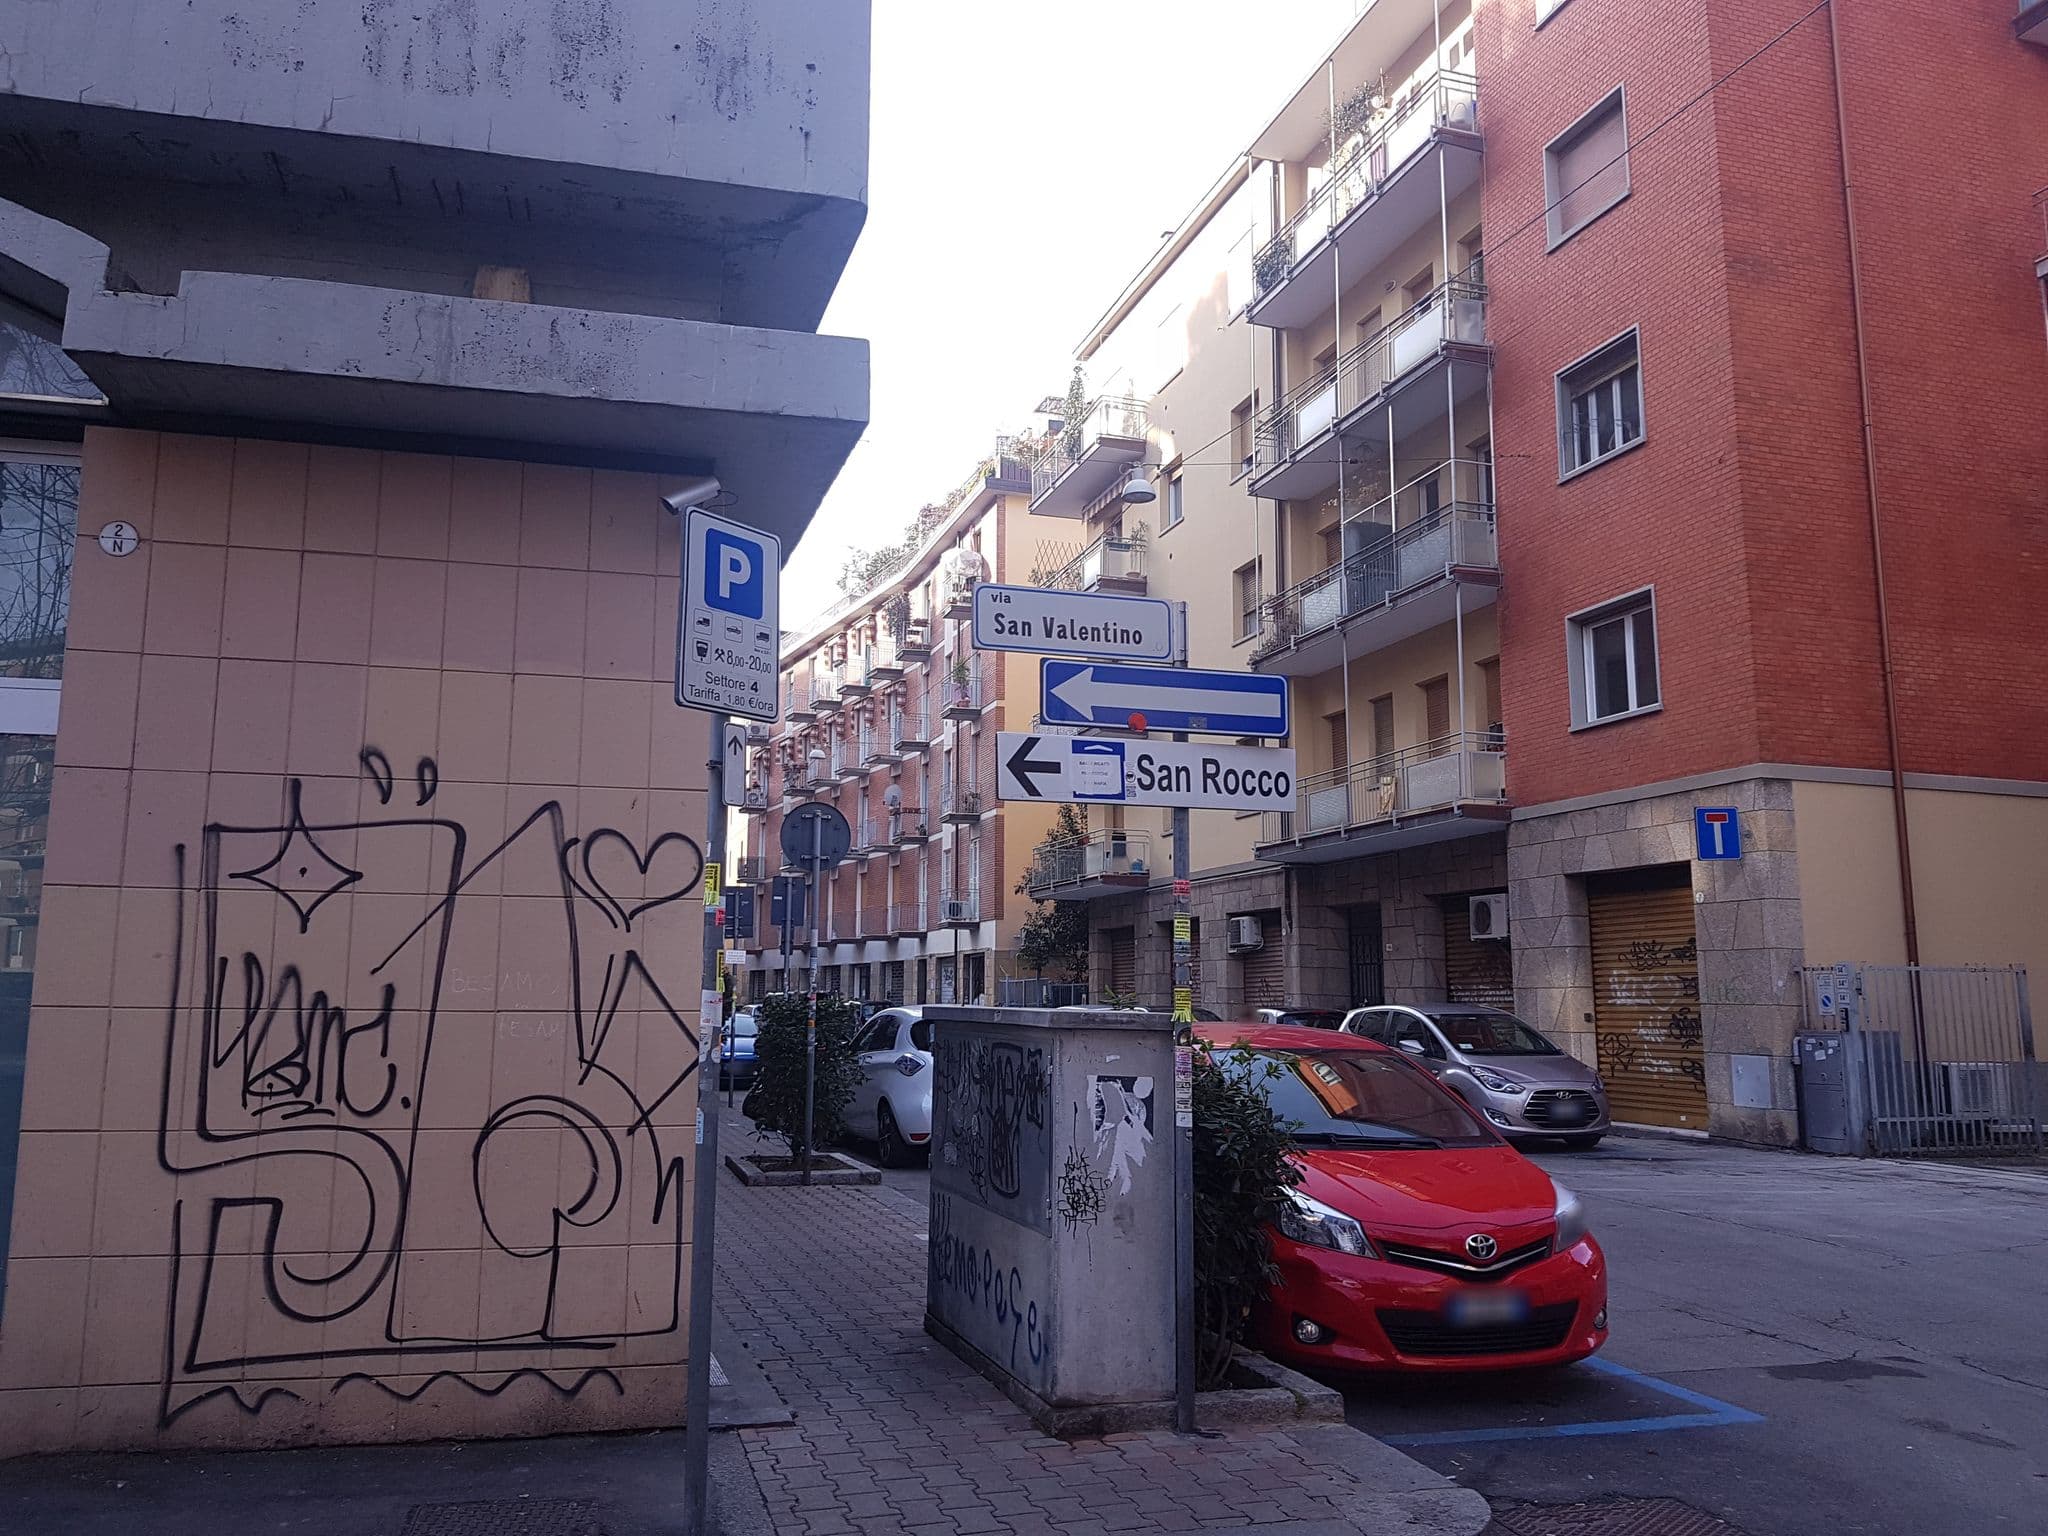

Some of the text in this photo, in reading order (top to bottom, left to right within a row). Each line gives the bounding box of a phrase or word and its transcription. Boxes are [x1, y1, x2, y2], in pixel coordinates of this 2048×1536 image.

[114, 524, 124, 537] 2
[112, 540, 123, 553] N
[719, 543, 751, 599] P
[991, 592, 1012, 604] via
[993, 612, 1143, 645] San Valentino
[705, 670, 759, 693] Settore 4
[688, 683, 721, 702] Tariffa
[1136, 753, 1291, 798] San Rocco
